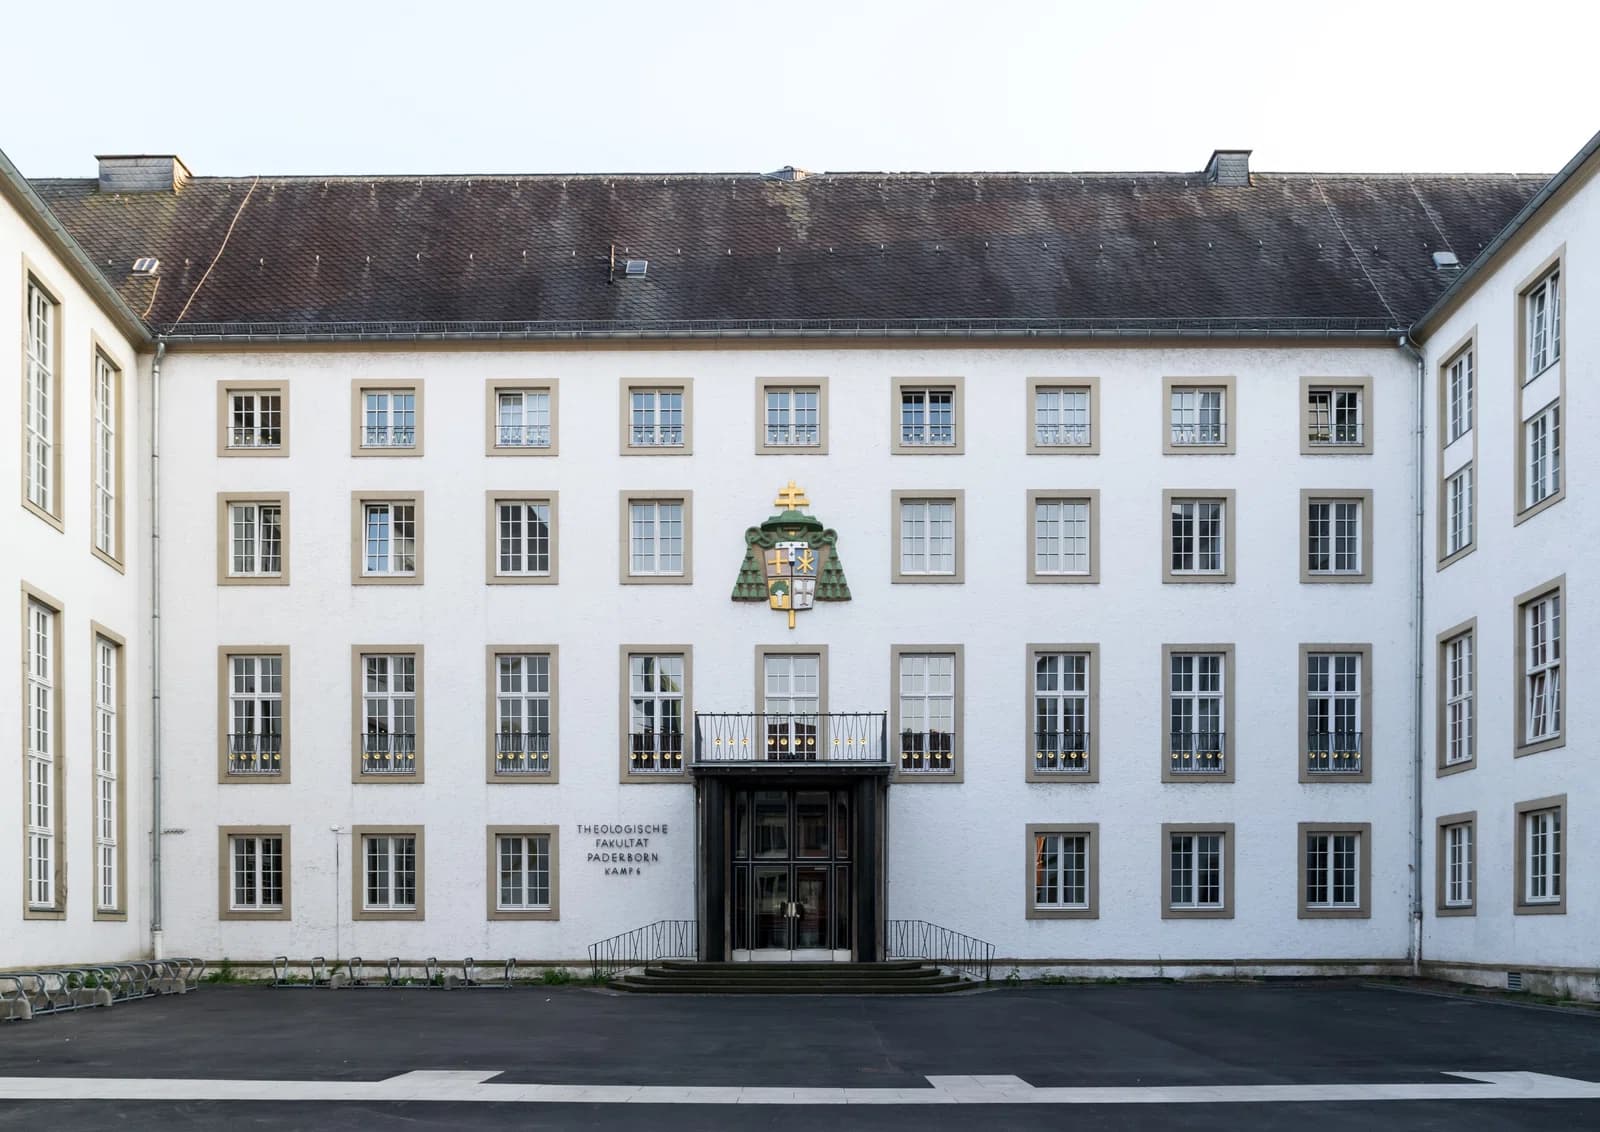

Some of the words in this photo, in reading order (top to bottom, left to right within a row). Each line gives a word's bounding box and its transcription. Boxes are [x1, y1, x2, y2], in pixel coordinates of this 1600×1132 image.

[577, 824, 669, 835] THEOLOGISCHE
[587, 853, 659, 862] PADERBORN
[605, 867, 633, 876] KAMP
